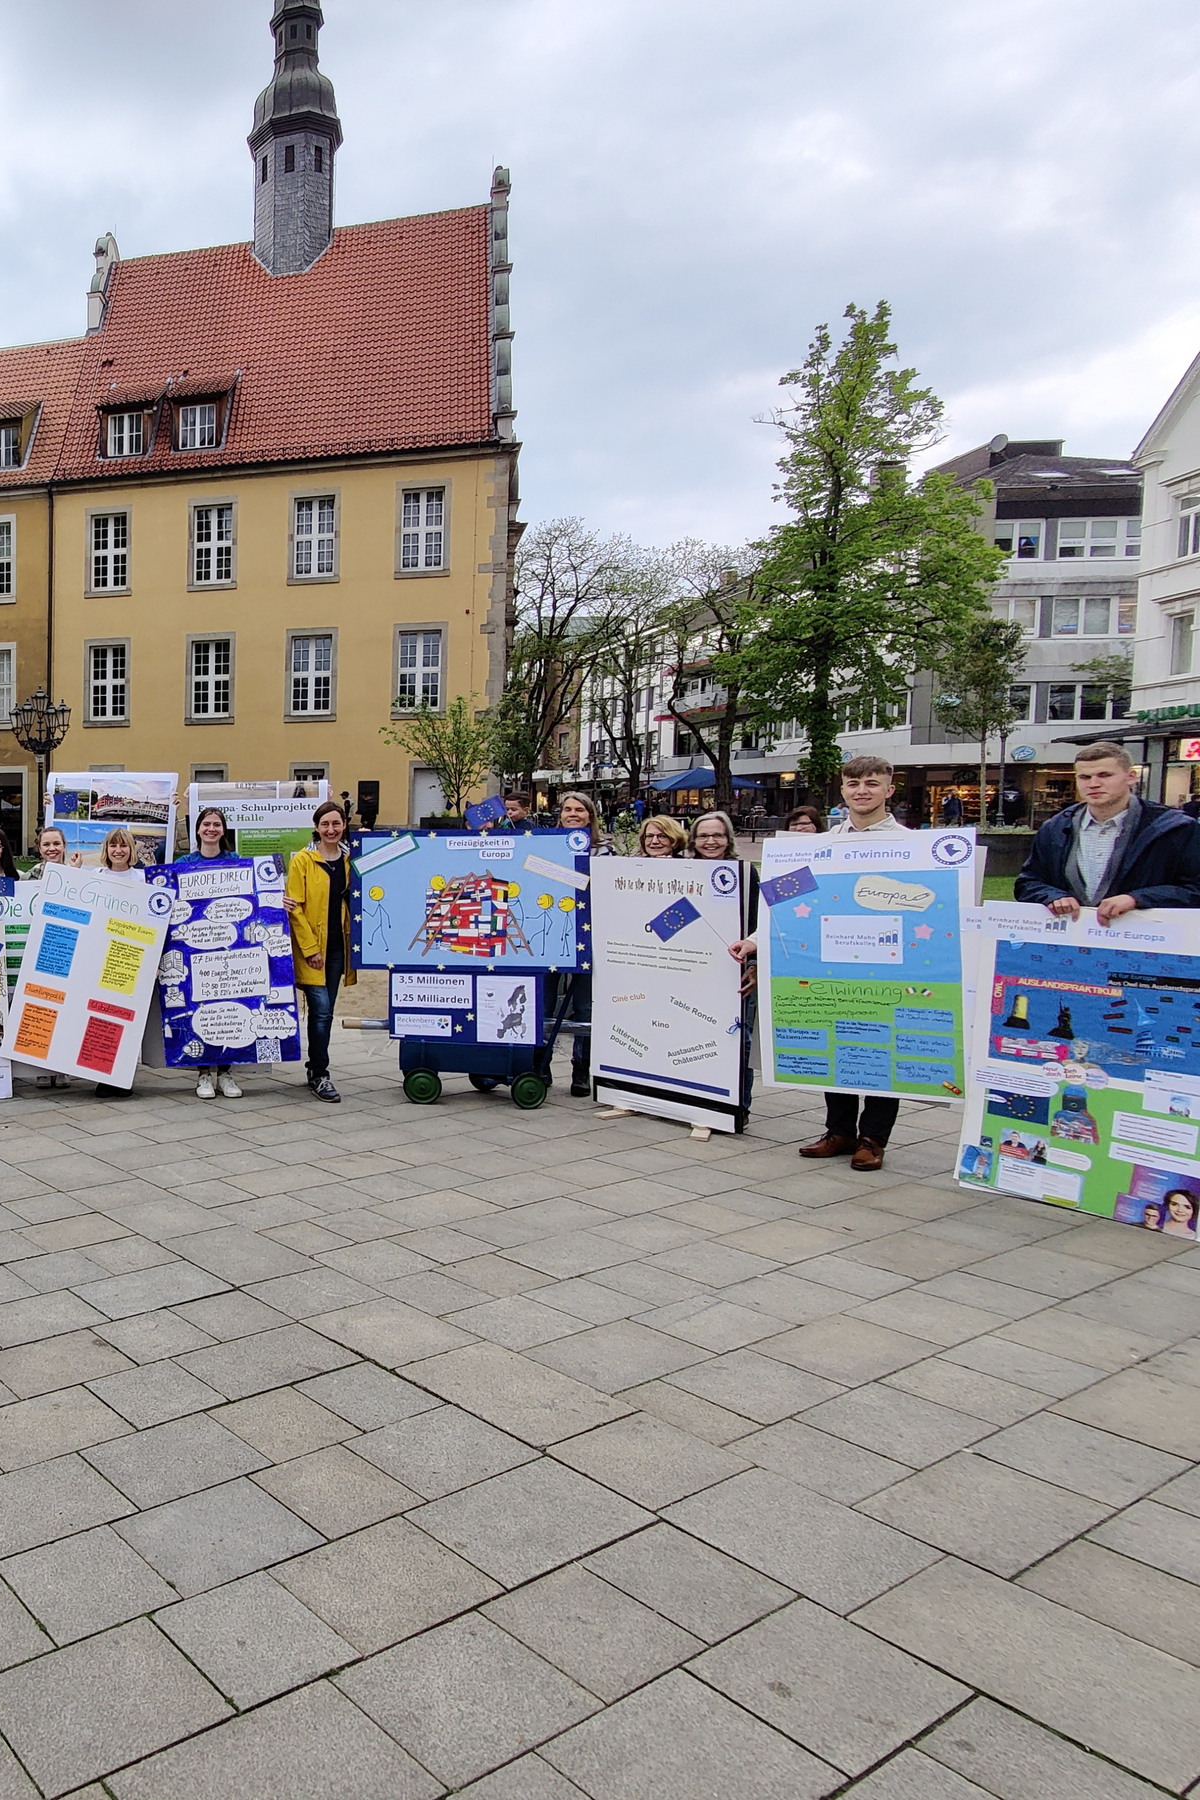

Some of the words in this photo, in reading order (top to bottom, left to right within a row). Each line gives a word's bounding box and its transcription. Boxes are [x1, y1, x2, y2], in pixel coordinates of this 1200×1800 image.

[241, 803, 317, 814] Schulprojekte
[236, 814, 265, 822] Halle
[448, 839, 500, 848] Freizügigkeit
[481, 850, 511, 859] Europa
[844, 849, 911, 860] eTwinning
[179, 873, 217, 889] EUROPE
[220, 870, 250, 884] DIRECT
[185, 889, 205, 898] Kreis
[209, 885, 240, 897] Gütersloh
[857, 887, 914, 904] Europa
[79, 880, 140, 916] Grünen
[987, 916, 1020, 924] Reinhard
[997, 923, 1042, 933] Berufskolleg
[1087, 928, 1102, 936] Fit
[1104, 929, 1121, 938] für
[1124, 931, 1166, 942] Europa
[192, 956, 203, 964] 27
[399, 976, 414, 985] 3,5
[416, 976, 465, 986] Millionen
[1018, 977, 1123, 998] AUSLANDSPRAKTIKUM
[394, 993, 414, 1002] 1,25
[417, 994, 470, 1004] Milliarden
[629, 992, 646, 1001] club
[669, 995, 691, 1012] Table
[691, 1007, 718, 1025] Ronde
[397, 1016, 436, 1025] Reckenberg
[651, 1019, 670, 1029] Kino
[611, 1024, 650, 1052] Littérature
[609, 1034, 628, 1047] pour
[628, 1044, 644, 1058] tous
[667, 1043, 704, 1058] Austausch
[705, 1040, 718, 1049] mit
[672, 1051, 718, 1066] Châteauroux
